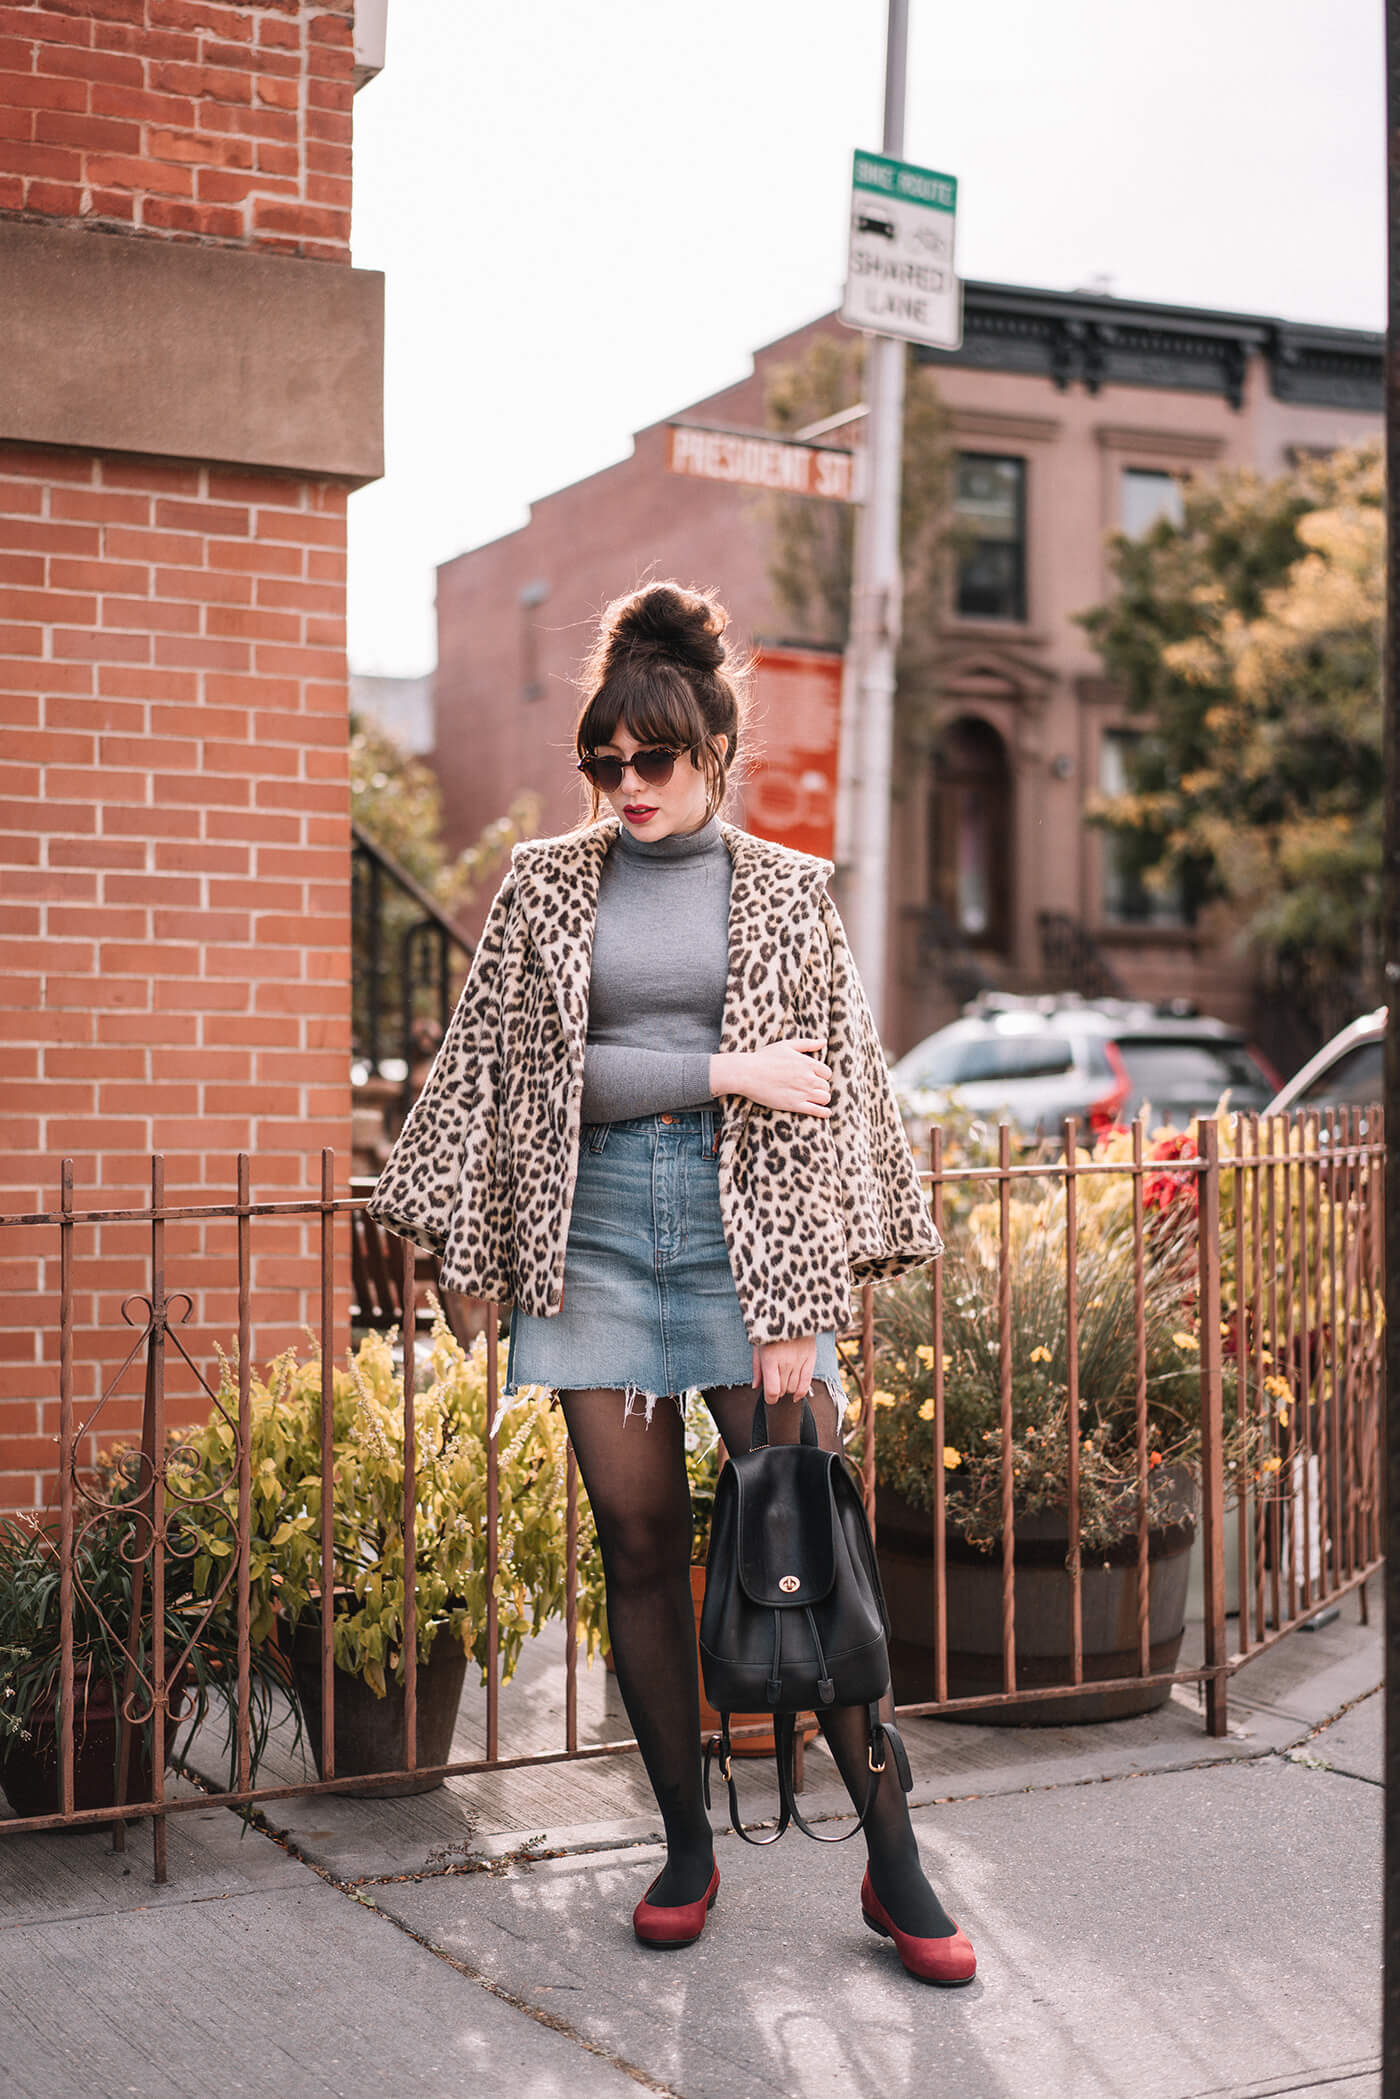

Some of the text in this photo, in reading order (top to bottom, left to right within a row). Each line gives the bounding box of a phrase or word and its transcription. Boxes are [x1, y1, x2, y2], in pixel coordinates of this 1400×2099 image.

[856, 159, 954, 206] BIKE ROUTE
[851, 251, 944, 293] SHARED
[866, 288, 928, 323] LANE
[672, 427, 848, 495] PRESIDENT ST
